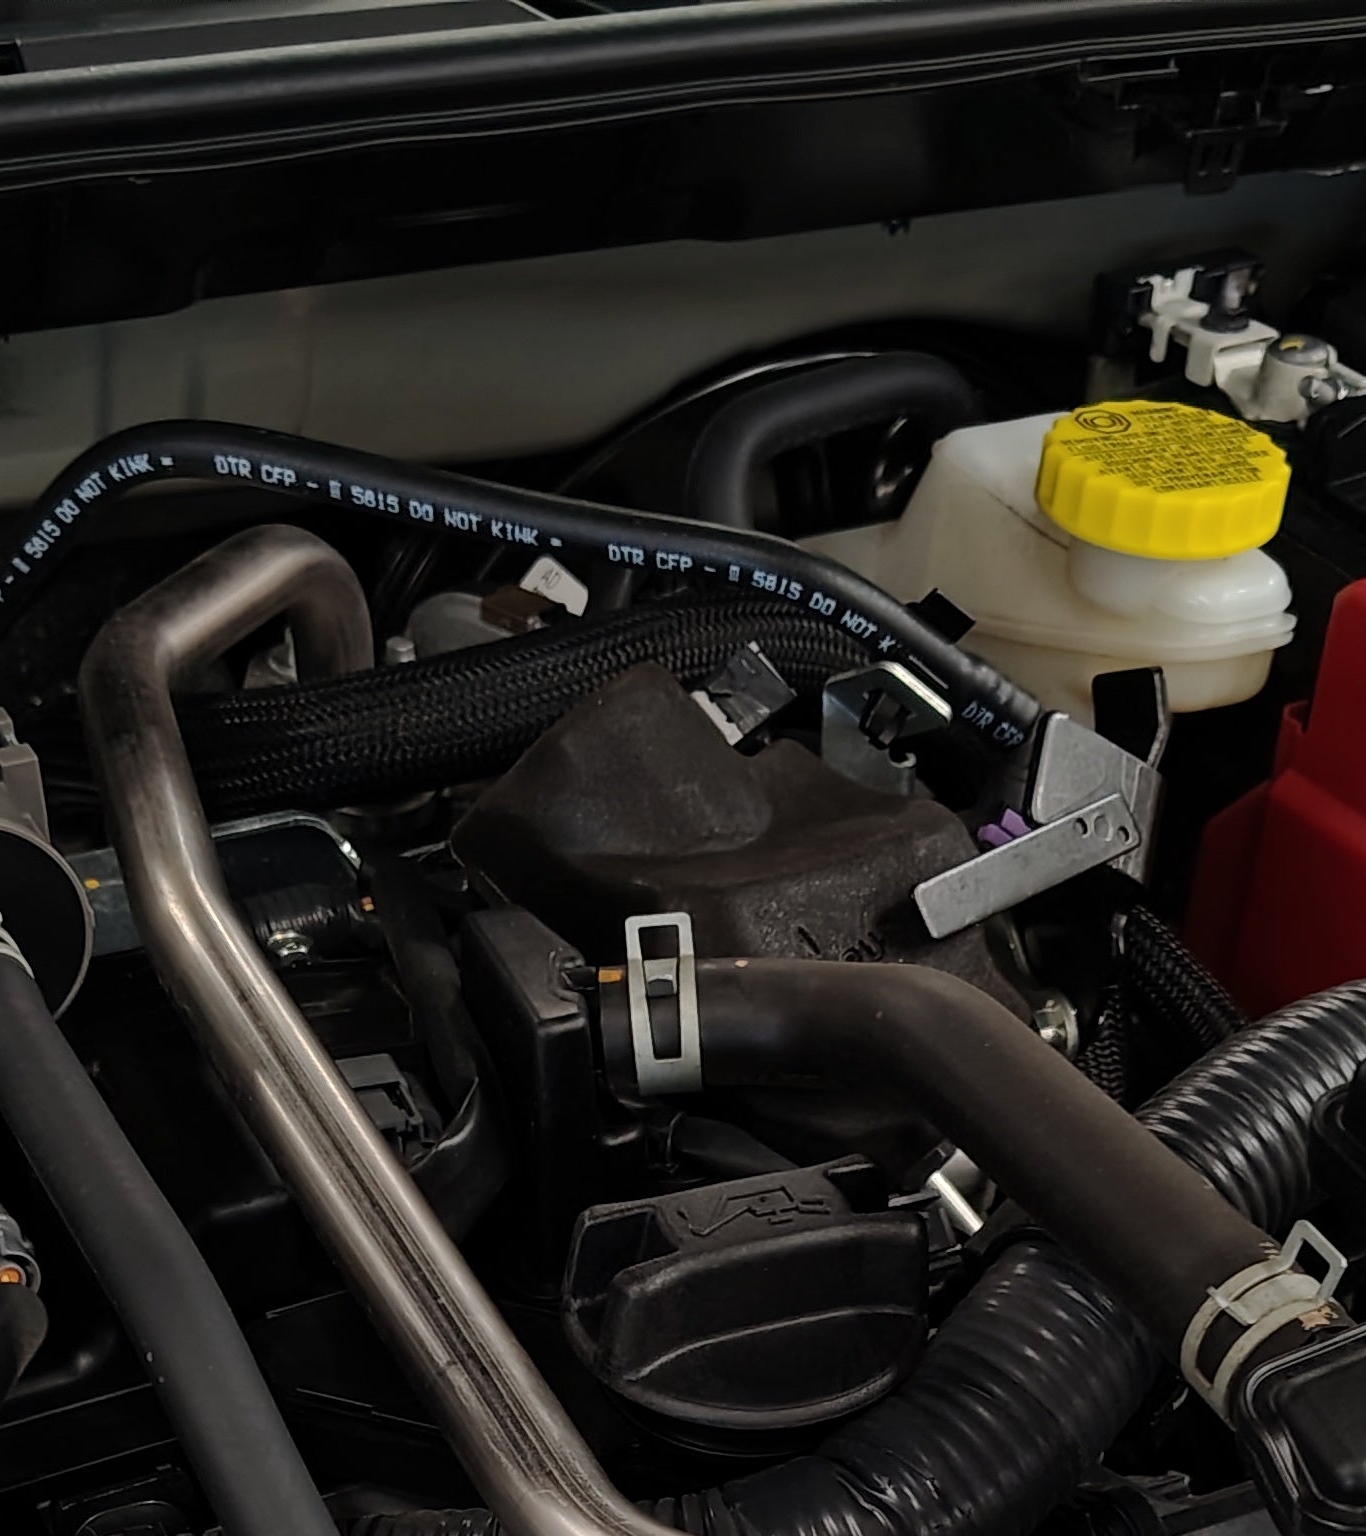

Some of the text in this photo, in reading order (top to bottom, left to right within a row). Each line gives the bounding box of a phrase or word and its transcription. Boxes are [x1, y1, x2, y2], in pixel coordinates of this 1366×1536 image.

[74, 471, 109, 504] NOT
[107, 452, 156, 483] KINK
[444, 507, 483, 534] NOT
[490, 519, 540, 547] KINK
[839, 609, 878, 640] NOT
